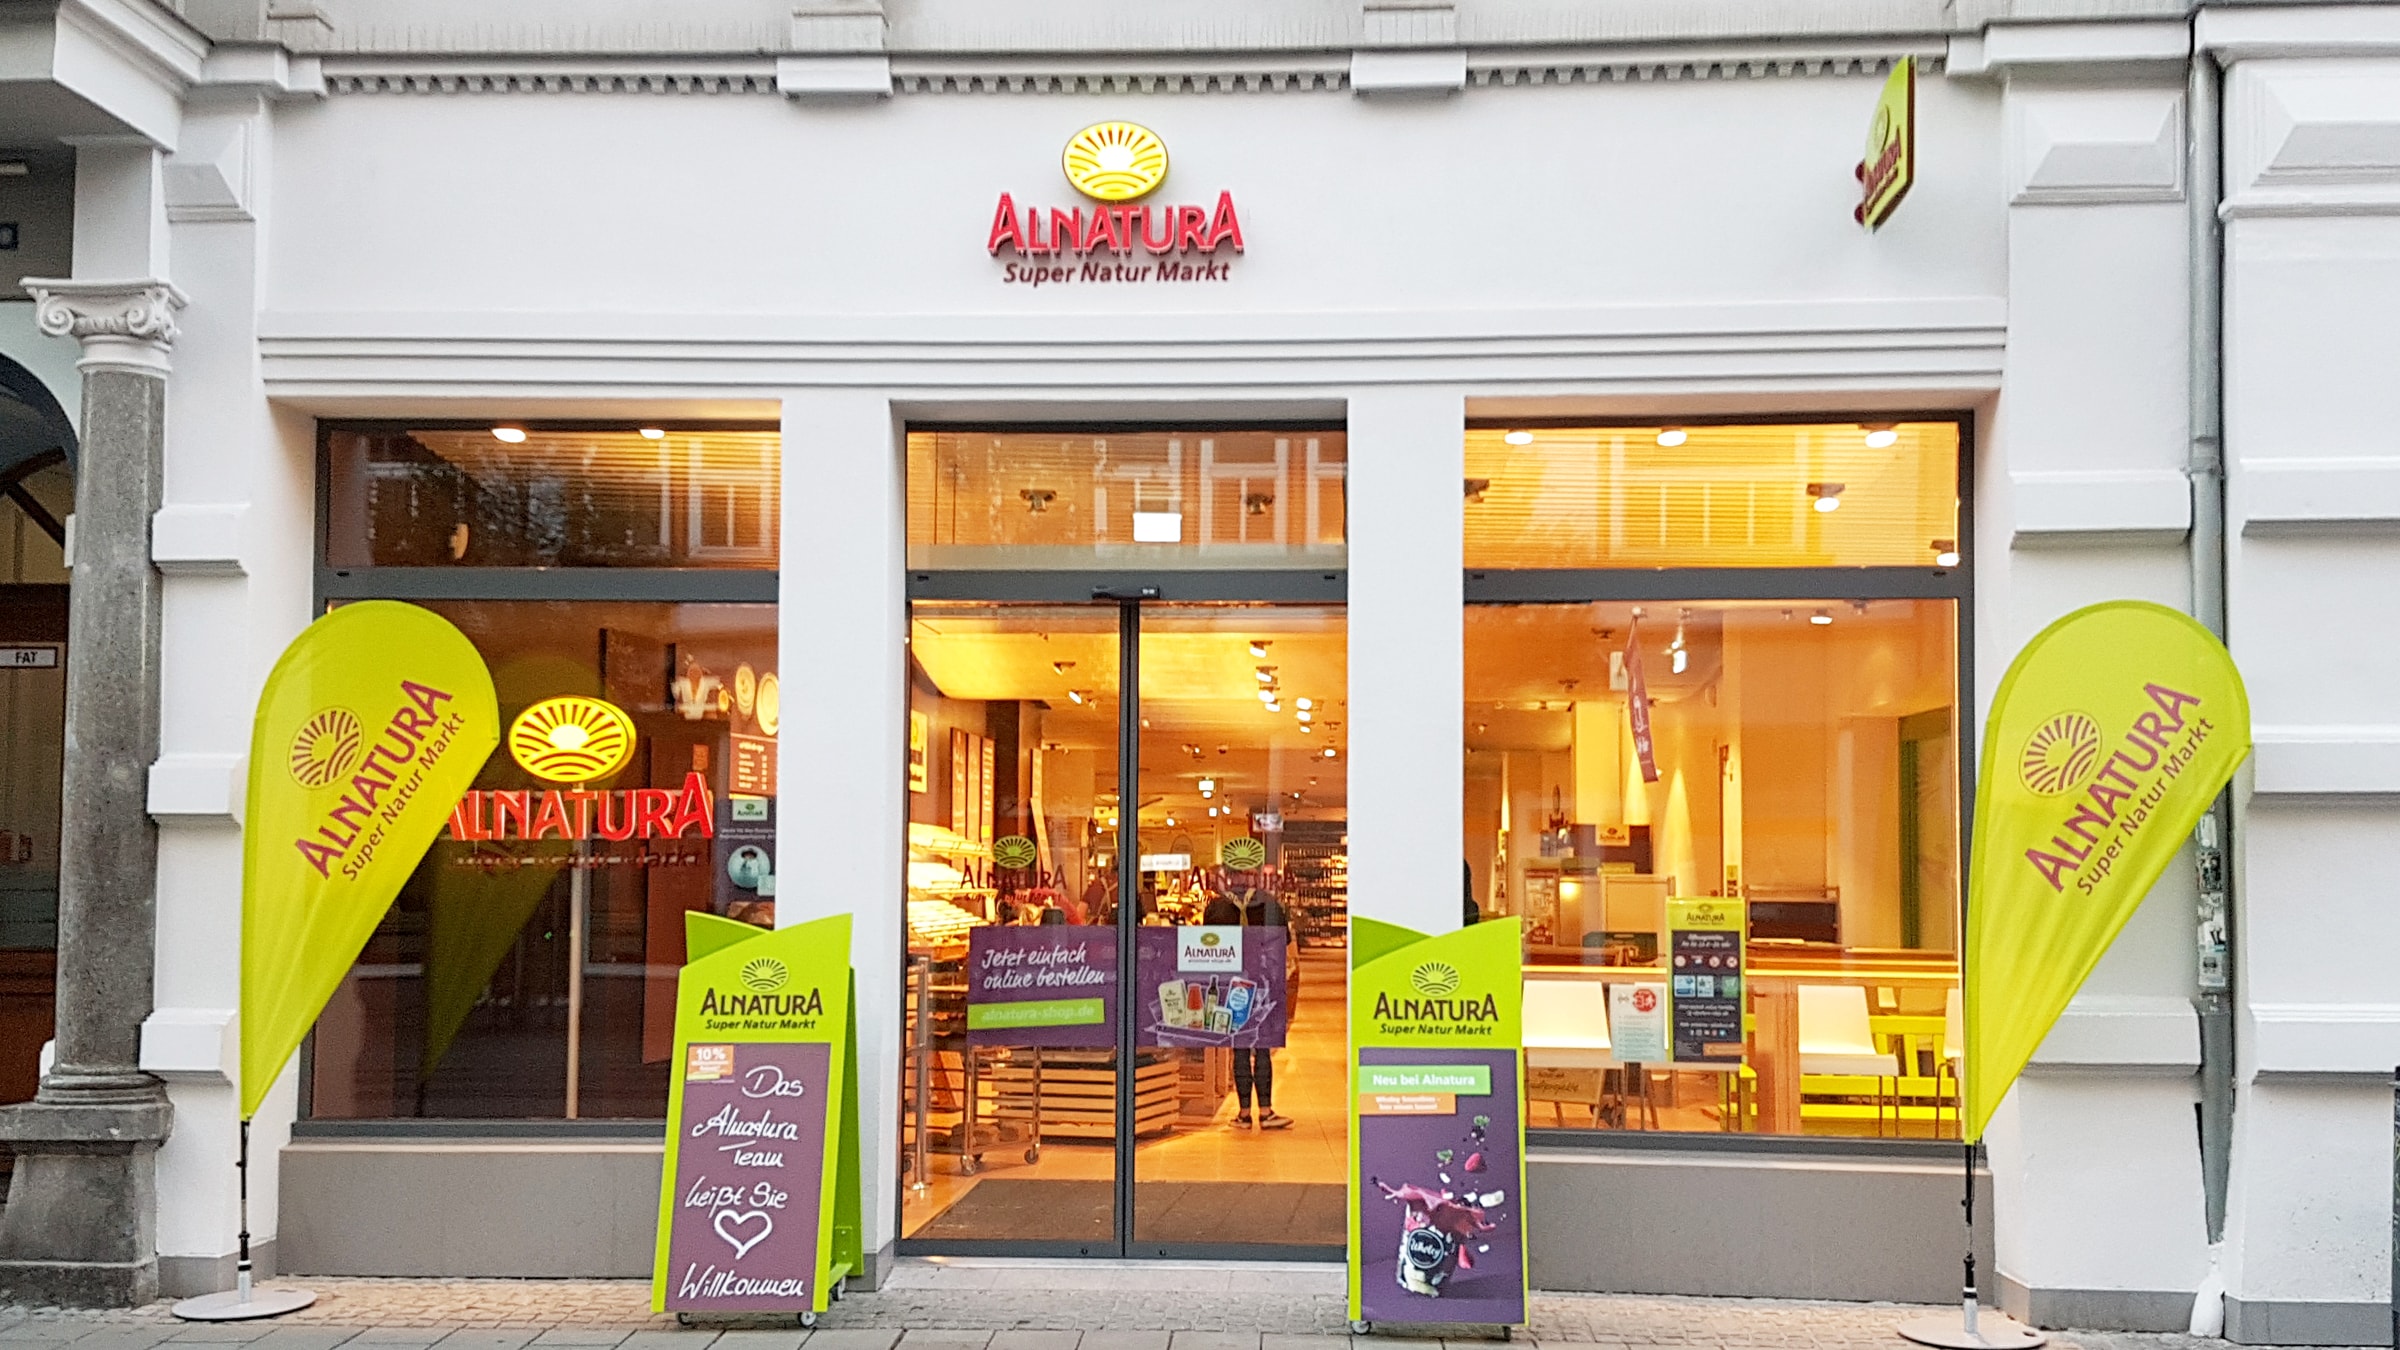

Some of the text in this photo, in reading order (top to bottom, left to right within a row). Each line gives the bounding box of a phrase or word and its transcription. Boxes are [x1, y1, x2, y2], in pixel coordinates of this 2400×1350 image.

[987, 190, 1244, 255] ALNATURA
[1003, 260, 1230, 287] Super Natur Markt
[15, 651, 38, 664] FAT
[295, 680, 453, 880] ALNATURA
[2025, 682, 2201, 893] ALNATURA
[342, 711, 465, 881] Super Natur Markt
[2077, 716, 2215, 896] Super Natur Markt
[982, 942, 1086, 969] Jetzt einfach
[1184, 945, 1236, 958] ALNATURA
[984, 965, 1106, 989] online bestellen
[700, 987, 823, 1015] ALNATURA
[1373, 991, 1498, 1022] ALNATURA
[705, 1019, 816, 1031] Super Natur Markt
[1379, 1023, 1492, 1035] Super Natur Markt
[742, 1065, 804, 1098] Das
[1373, 1075, 1475, 1086] Neu bei Alnatura
[692, 1103, 799, 1140] Alnatura
[718, 1140, 784, 1167] Team
[685, 1176, 788, 1218] heißt Sie
[678, 1262, 804, 1299] Willkommen
